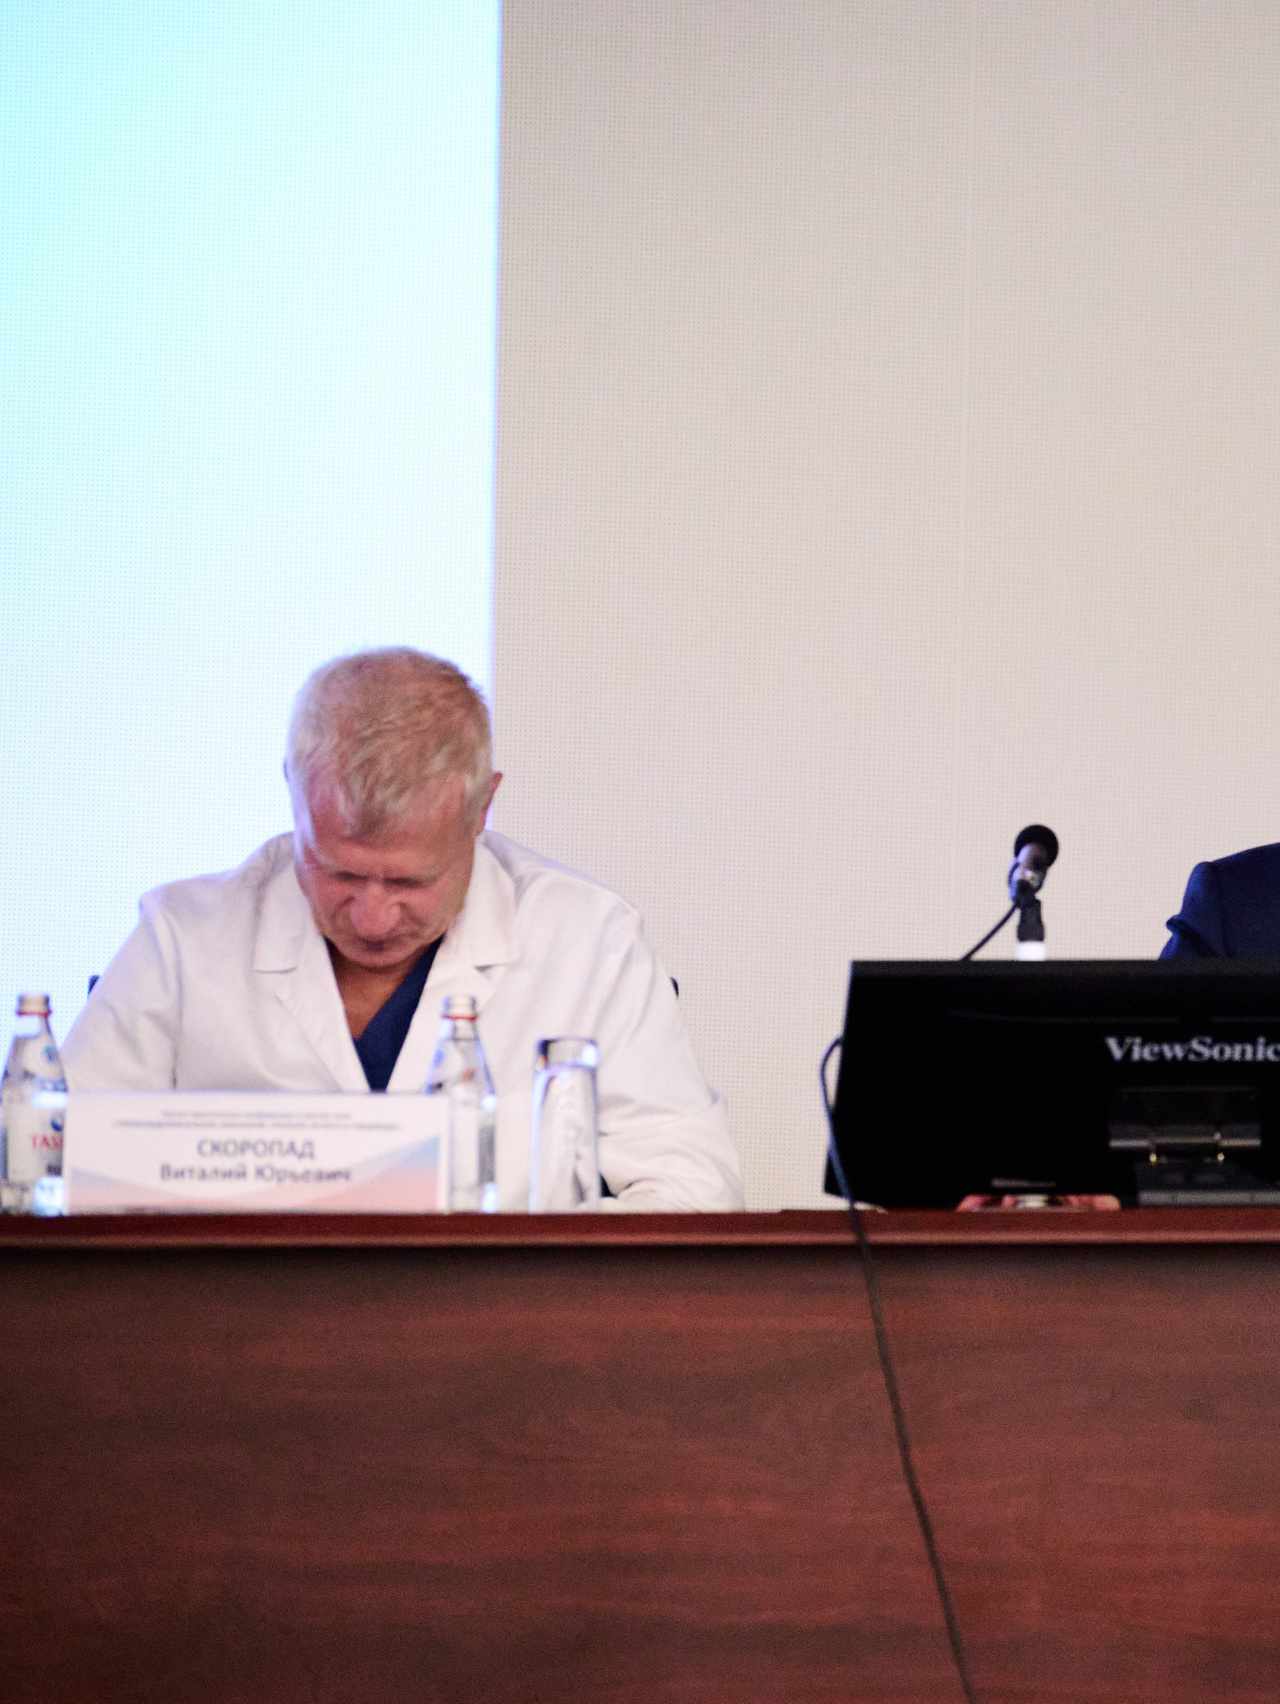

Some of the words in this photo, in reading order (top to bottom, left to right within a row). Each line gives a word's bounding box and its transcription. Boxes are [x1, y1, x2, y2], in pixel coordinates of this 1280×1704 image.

[197, 1139, 315, 1159] СКОРОПАД
[160, 1162, 247, 1181] Виталий
[254, 1164, 351, 1184] Юрьевич
